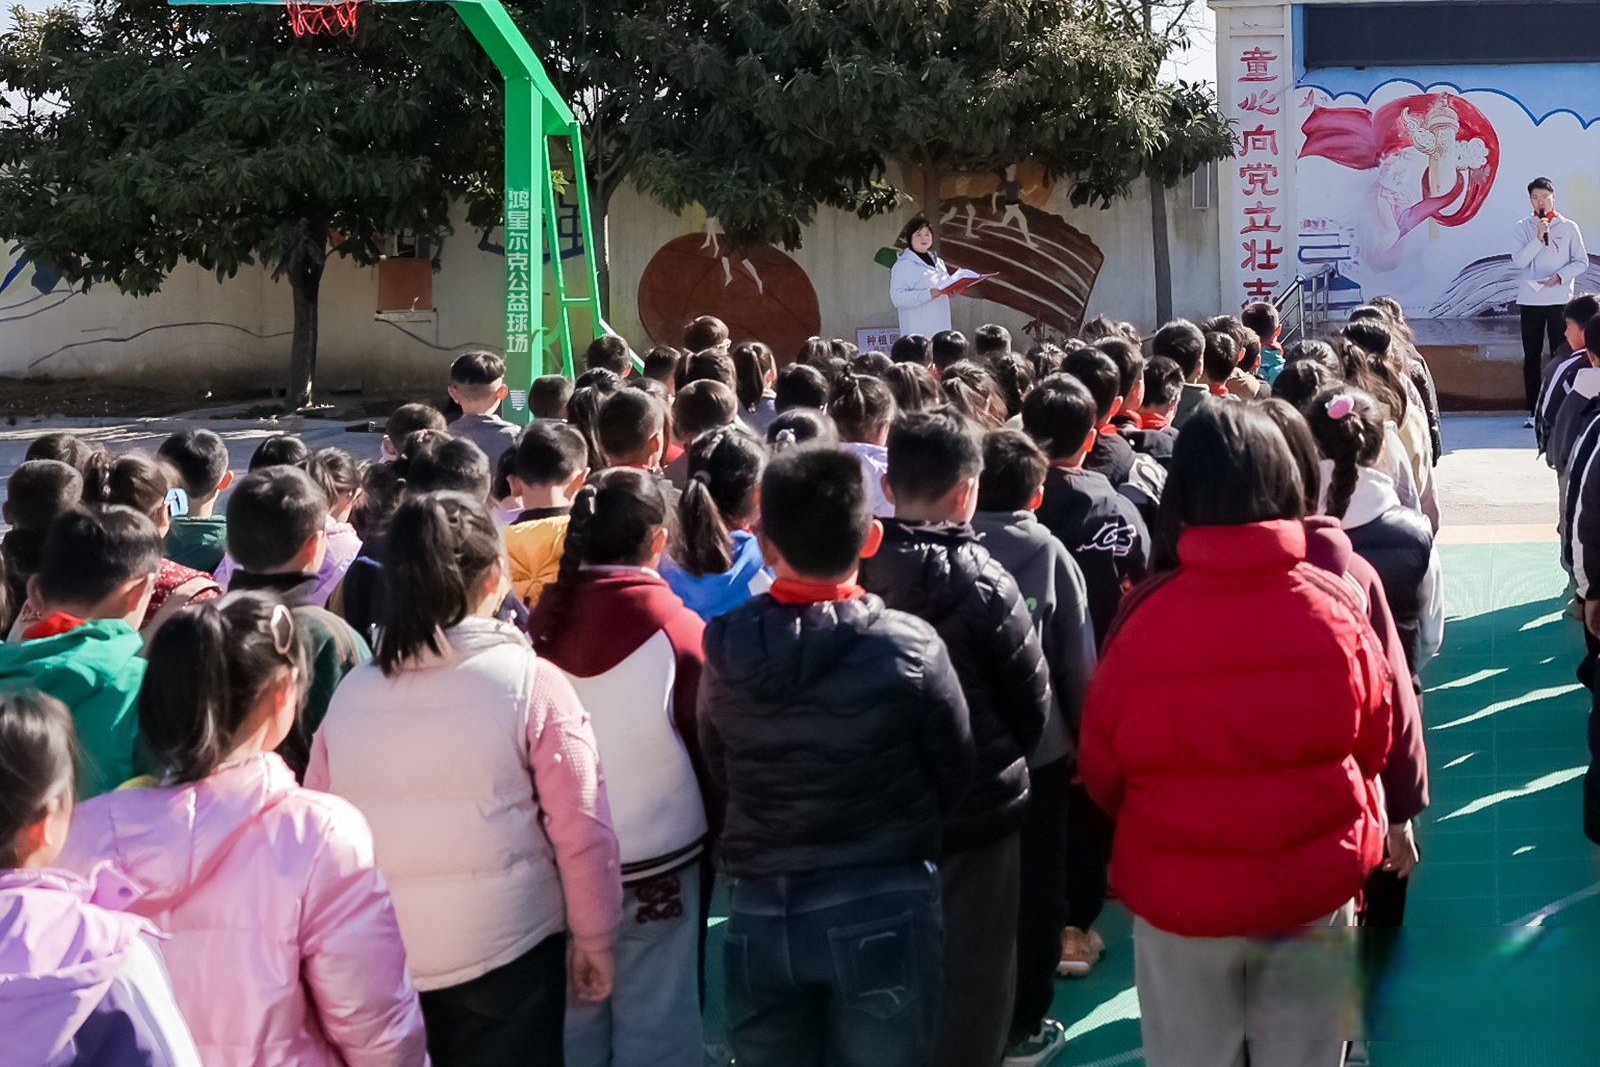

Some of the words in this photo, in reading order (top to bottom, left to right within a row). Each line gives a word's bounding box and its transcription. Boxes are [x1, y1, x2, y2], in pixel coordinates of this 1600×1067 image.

[506, 189, 530, 353] 鸿星尔克公益球场
